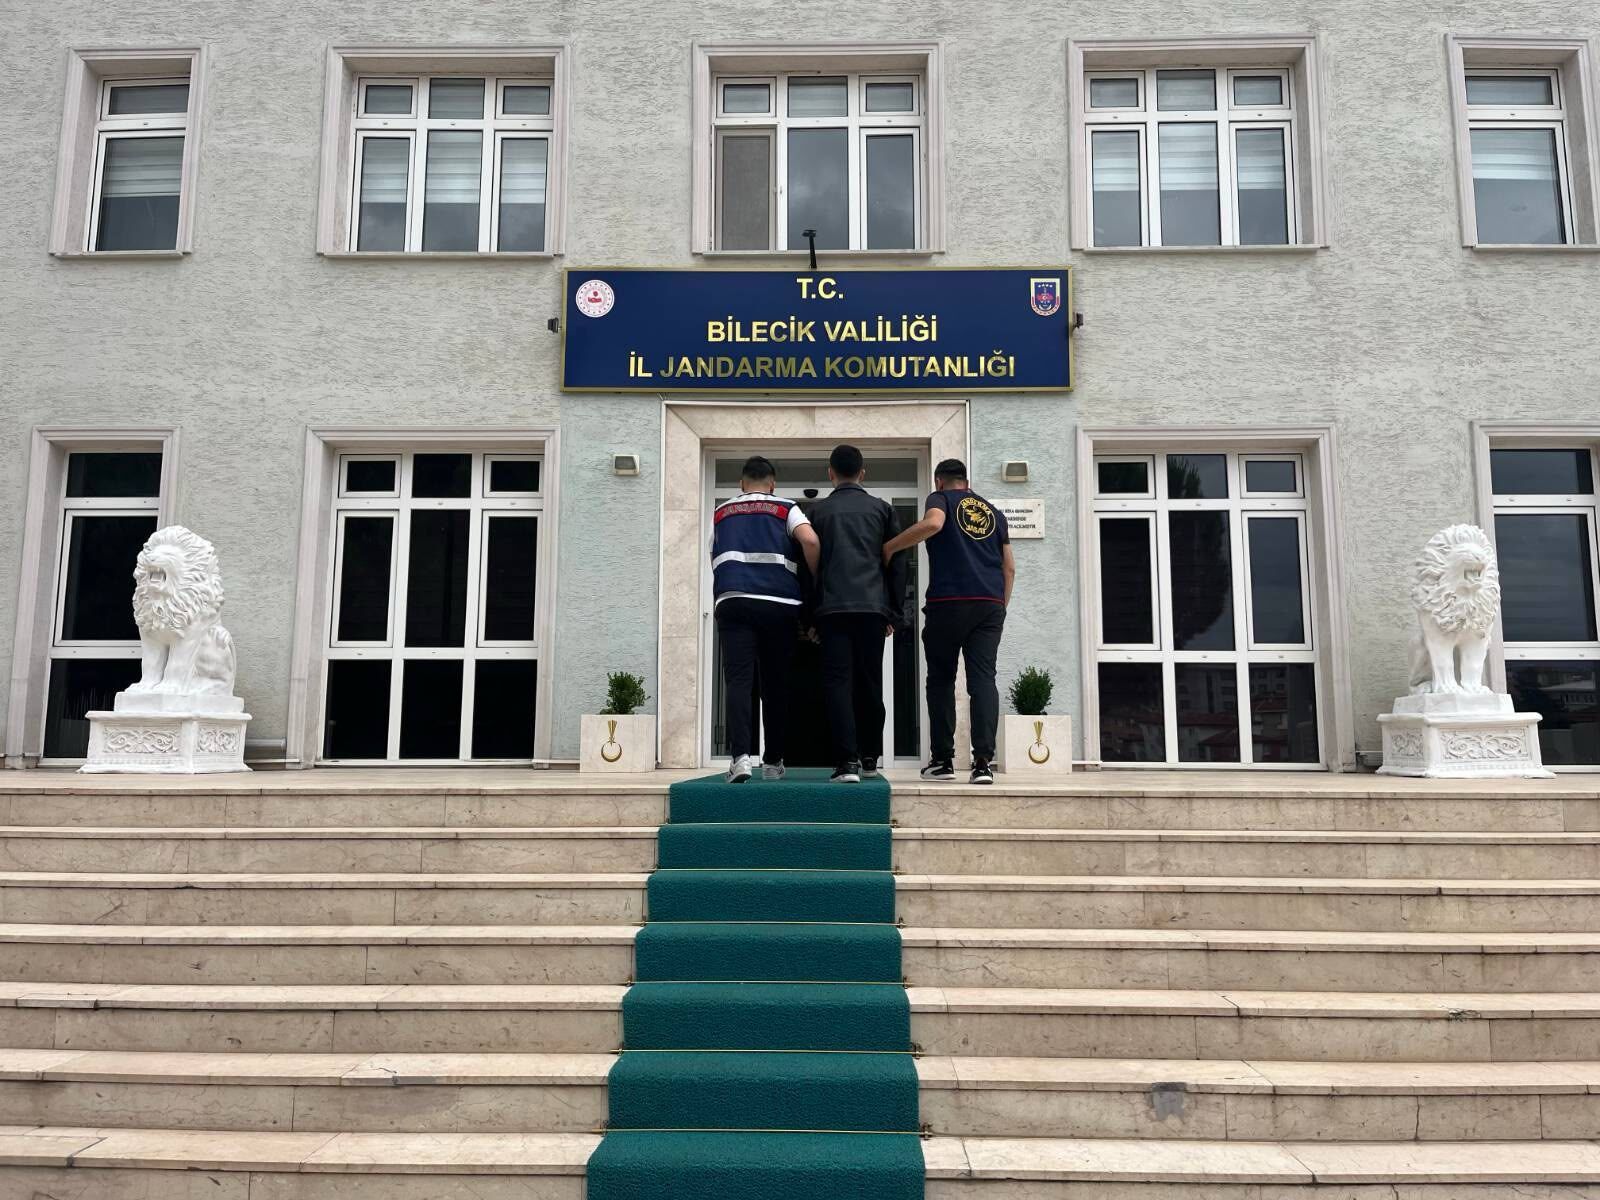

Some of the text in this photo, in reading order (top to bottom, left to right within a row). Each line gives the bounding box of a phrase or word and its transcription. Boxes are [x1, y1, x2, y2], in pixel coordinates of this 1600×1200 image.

[797, 277, 845, 299] T.C.
[706, 314, 938, 342] BİLECİK VALİLİĞİ
[628, 350, 1016, 379] İL JANDARMA KOMUTANLIĞI
